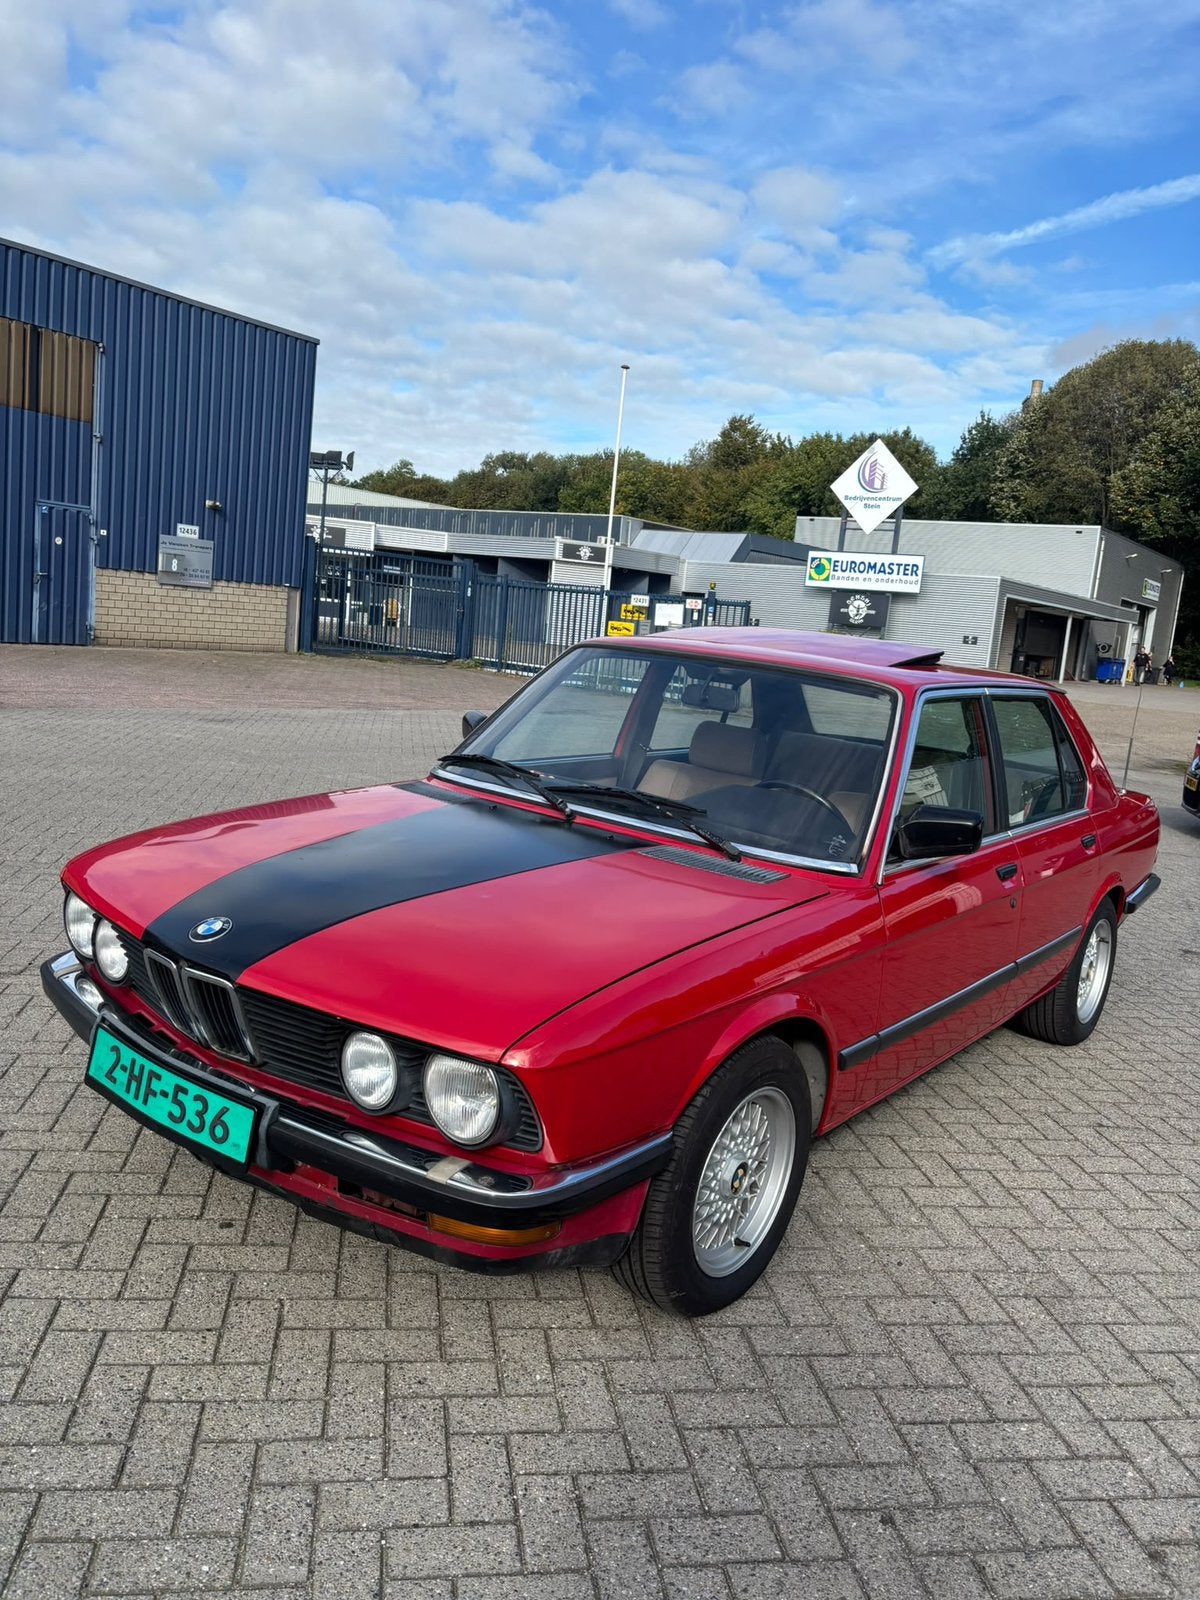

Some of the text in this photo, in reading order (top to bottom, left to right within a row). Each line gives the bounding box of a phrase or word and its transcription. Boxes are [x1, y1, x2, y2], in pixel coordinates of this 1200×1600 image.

[844, 494, 903, 502] Bedrijvencentrum
[172, 559, 178, 571] 8
[832, 560, 919, 577] EUROMASTER
[830, 574, 860, 583] Banden
[875, 576, 919, 586] onderhoud
[104, 1045, 230, 1145] 2-HF-536
